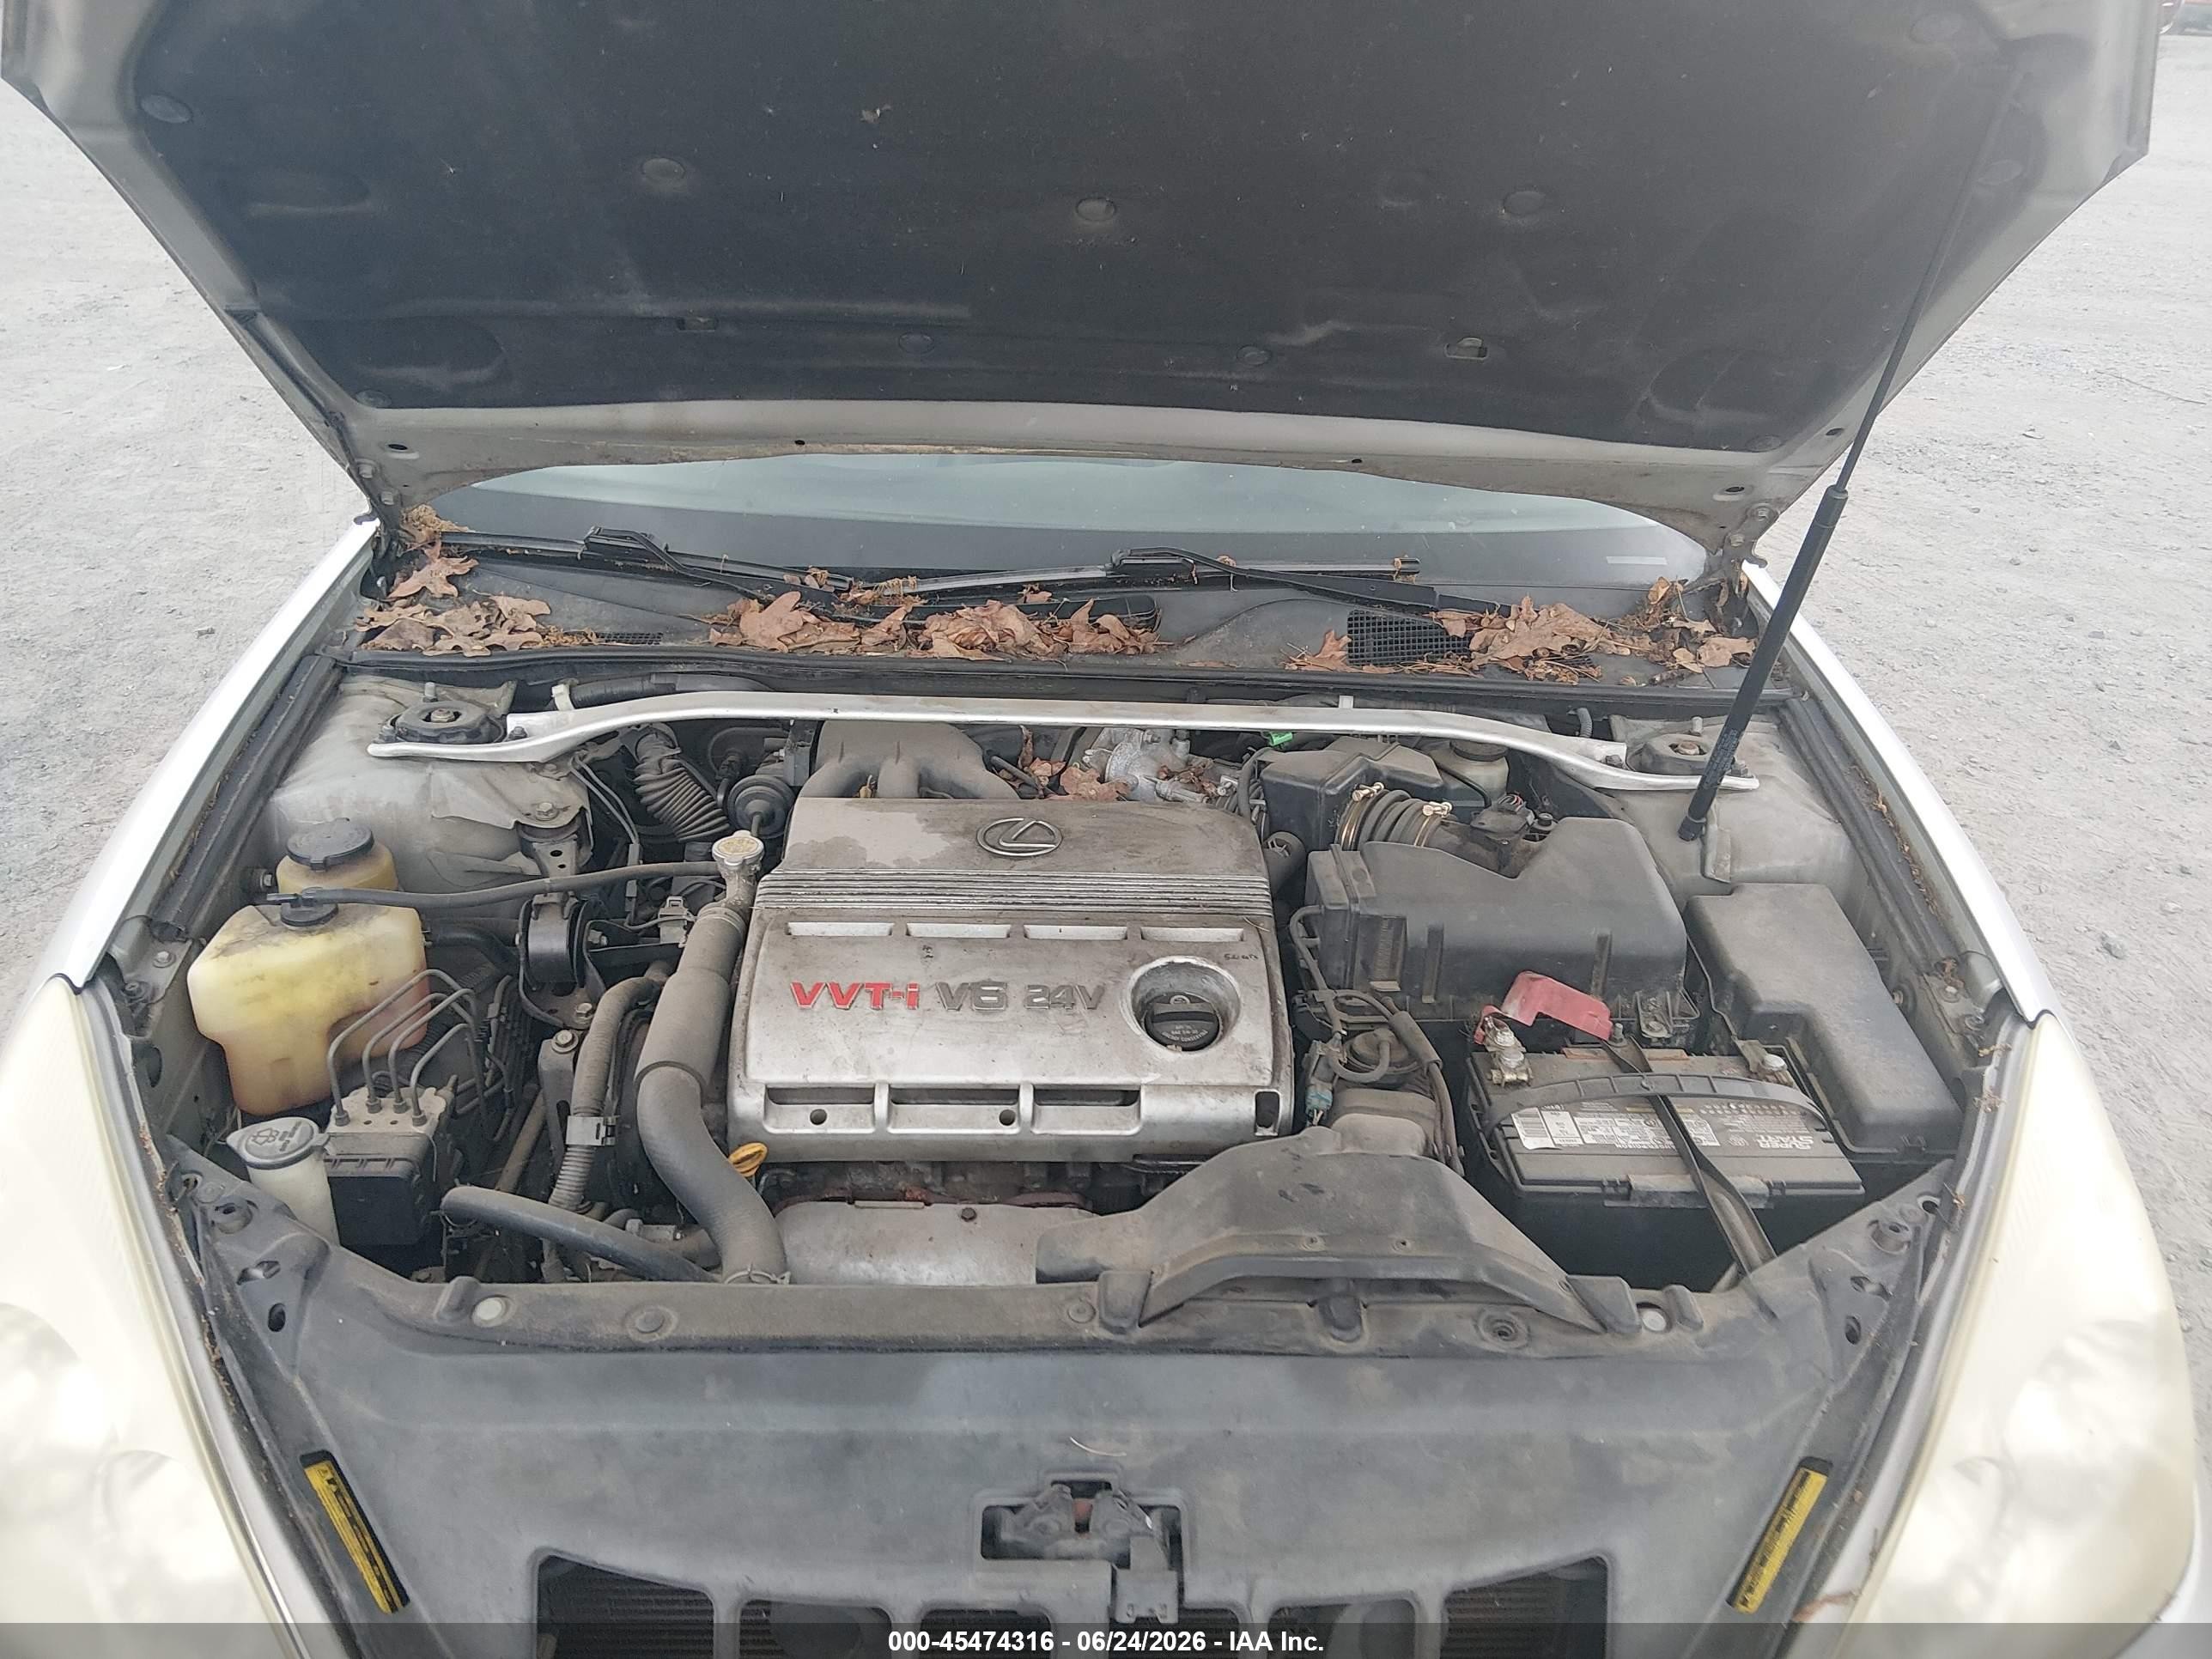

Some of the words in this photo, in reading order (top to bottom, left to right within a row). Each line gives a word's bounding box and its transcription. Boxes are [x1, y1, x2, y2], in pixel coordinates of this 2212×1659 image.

[790, 981, 920, 1010] VVT-i
[935, 980, 1008, 1011] V6
[1023, 984, 1106, 1011] 24V
[1758, 1134, 1814, 1144] START
[1759, 1141, 1812, 1150] SUPER
